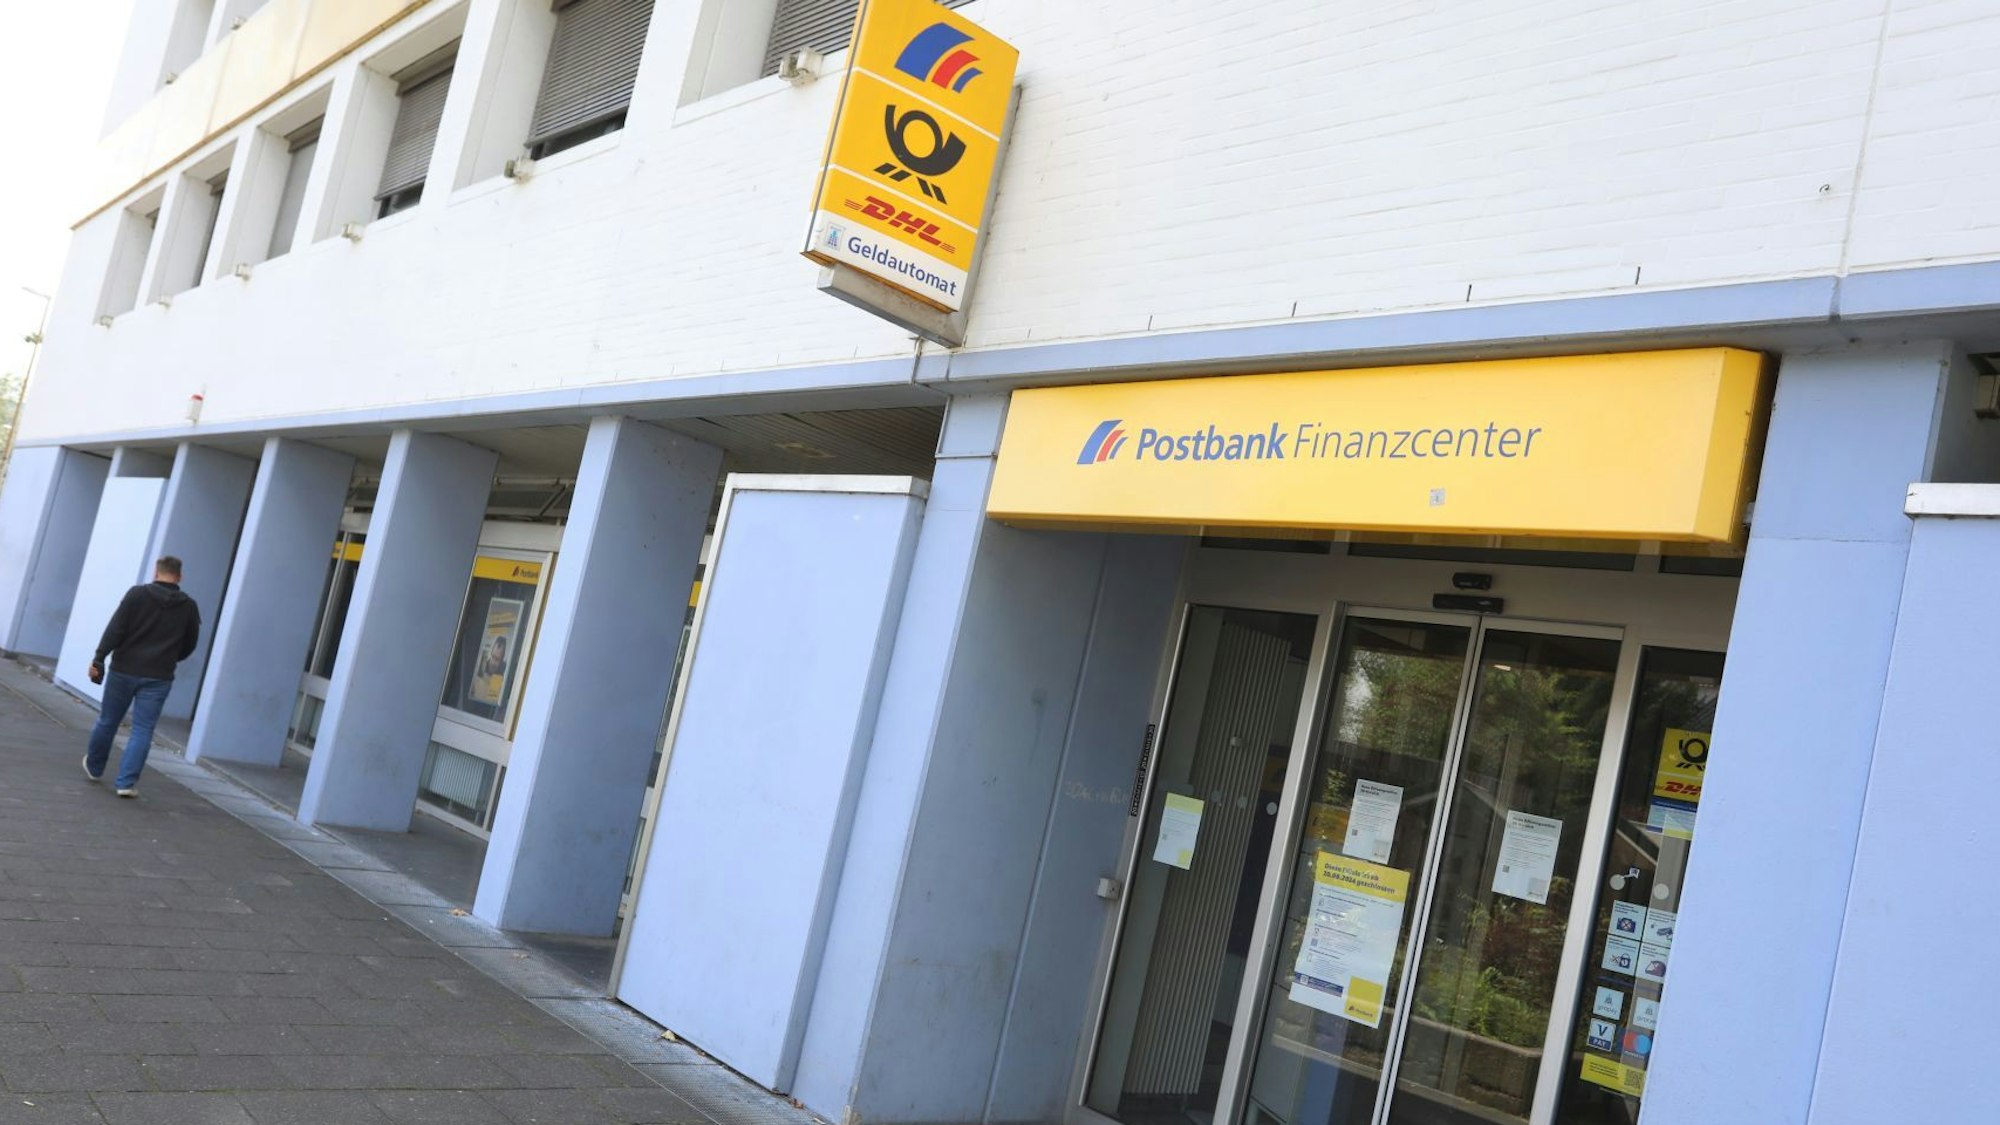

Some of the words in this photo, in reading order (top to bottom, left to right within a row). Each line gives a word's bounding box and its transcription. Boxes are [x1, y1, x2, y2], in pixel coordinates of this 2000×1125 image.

[860, 196, 943, 246] DHL
[847, 236, 957, 297] Geldautomat
[1136, 421, 1289, 462] Postbank
[1293, 420, 1542, 461] Finanzcenter
[1664, 781, 1701, 795] DH
[1592, 1039, 1607, 1047] PAY
[1597, 1023, 1608, 1037] V
